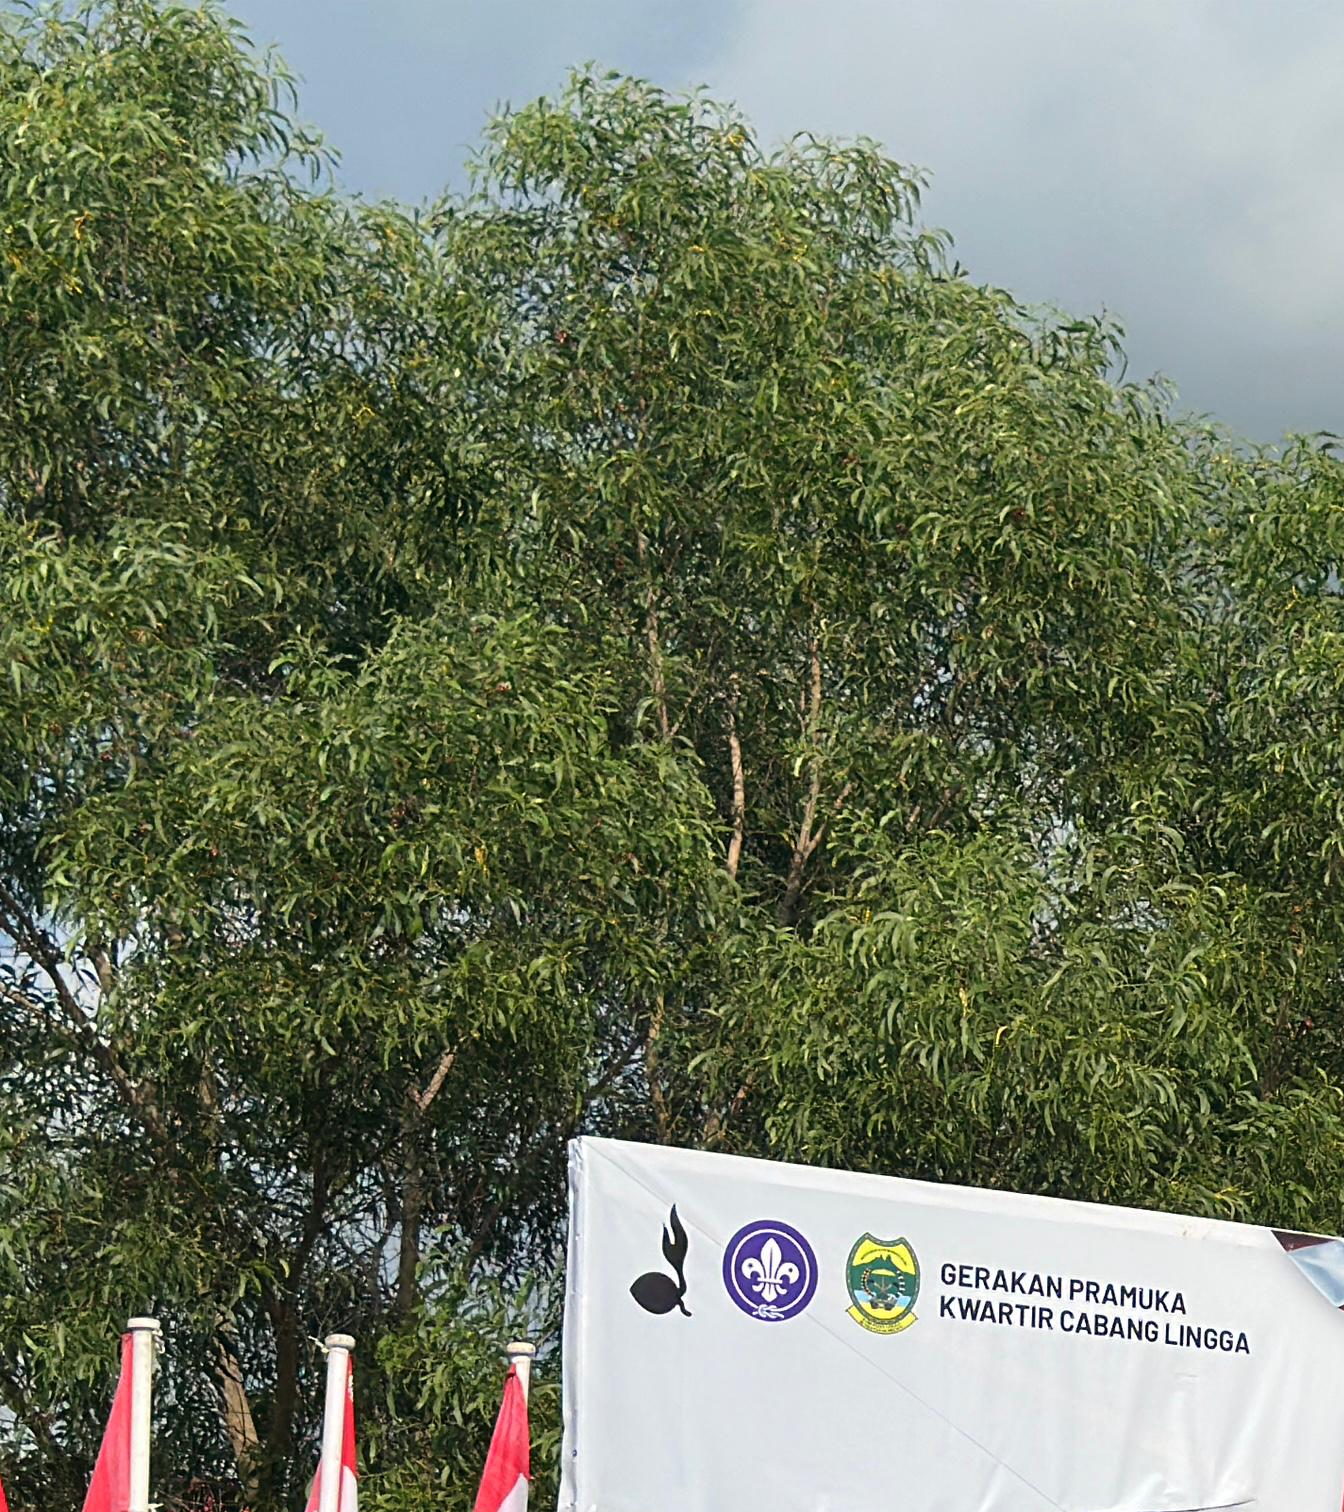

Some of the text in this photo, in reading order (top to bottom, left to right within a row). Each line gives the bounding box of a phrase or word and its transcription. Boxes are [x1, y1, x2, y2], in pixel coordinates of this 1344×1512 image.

[940, 1262, 1187, 1316] GERAKAN PRAMUKA
[939, 1295, 1055, 1331] KWARTIR
[1059, 1309, 1160, 1344] CABANG
[1164, 1324, 1252, 1356] LINGGA
